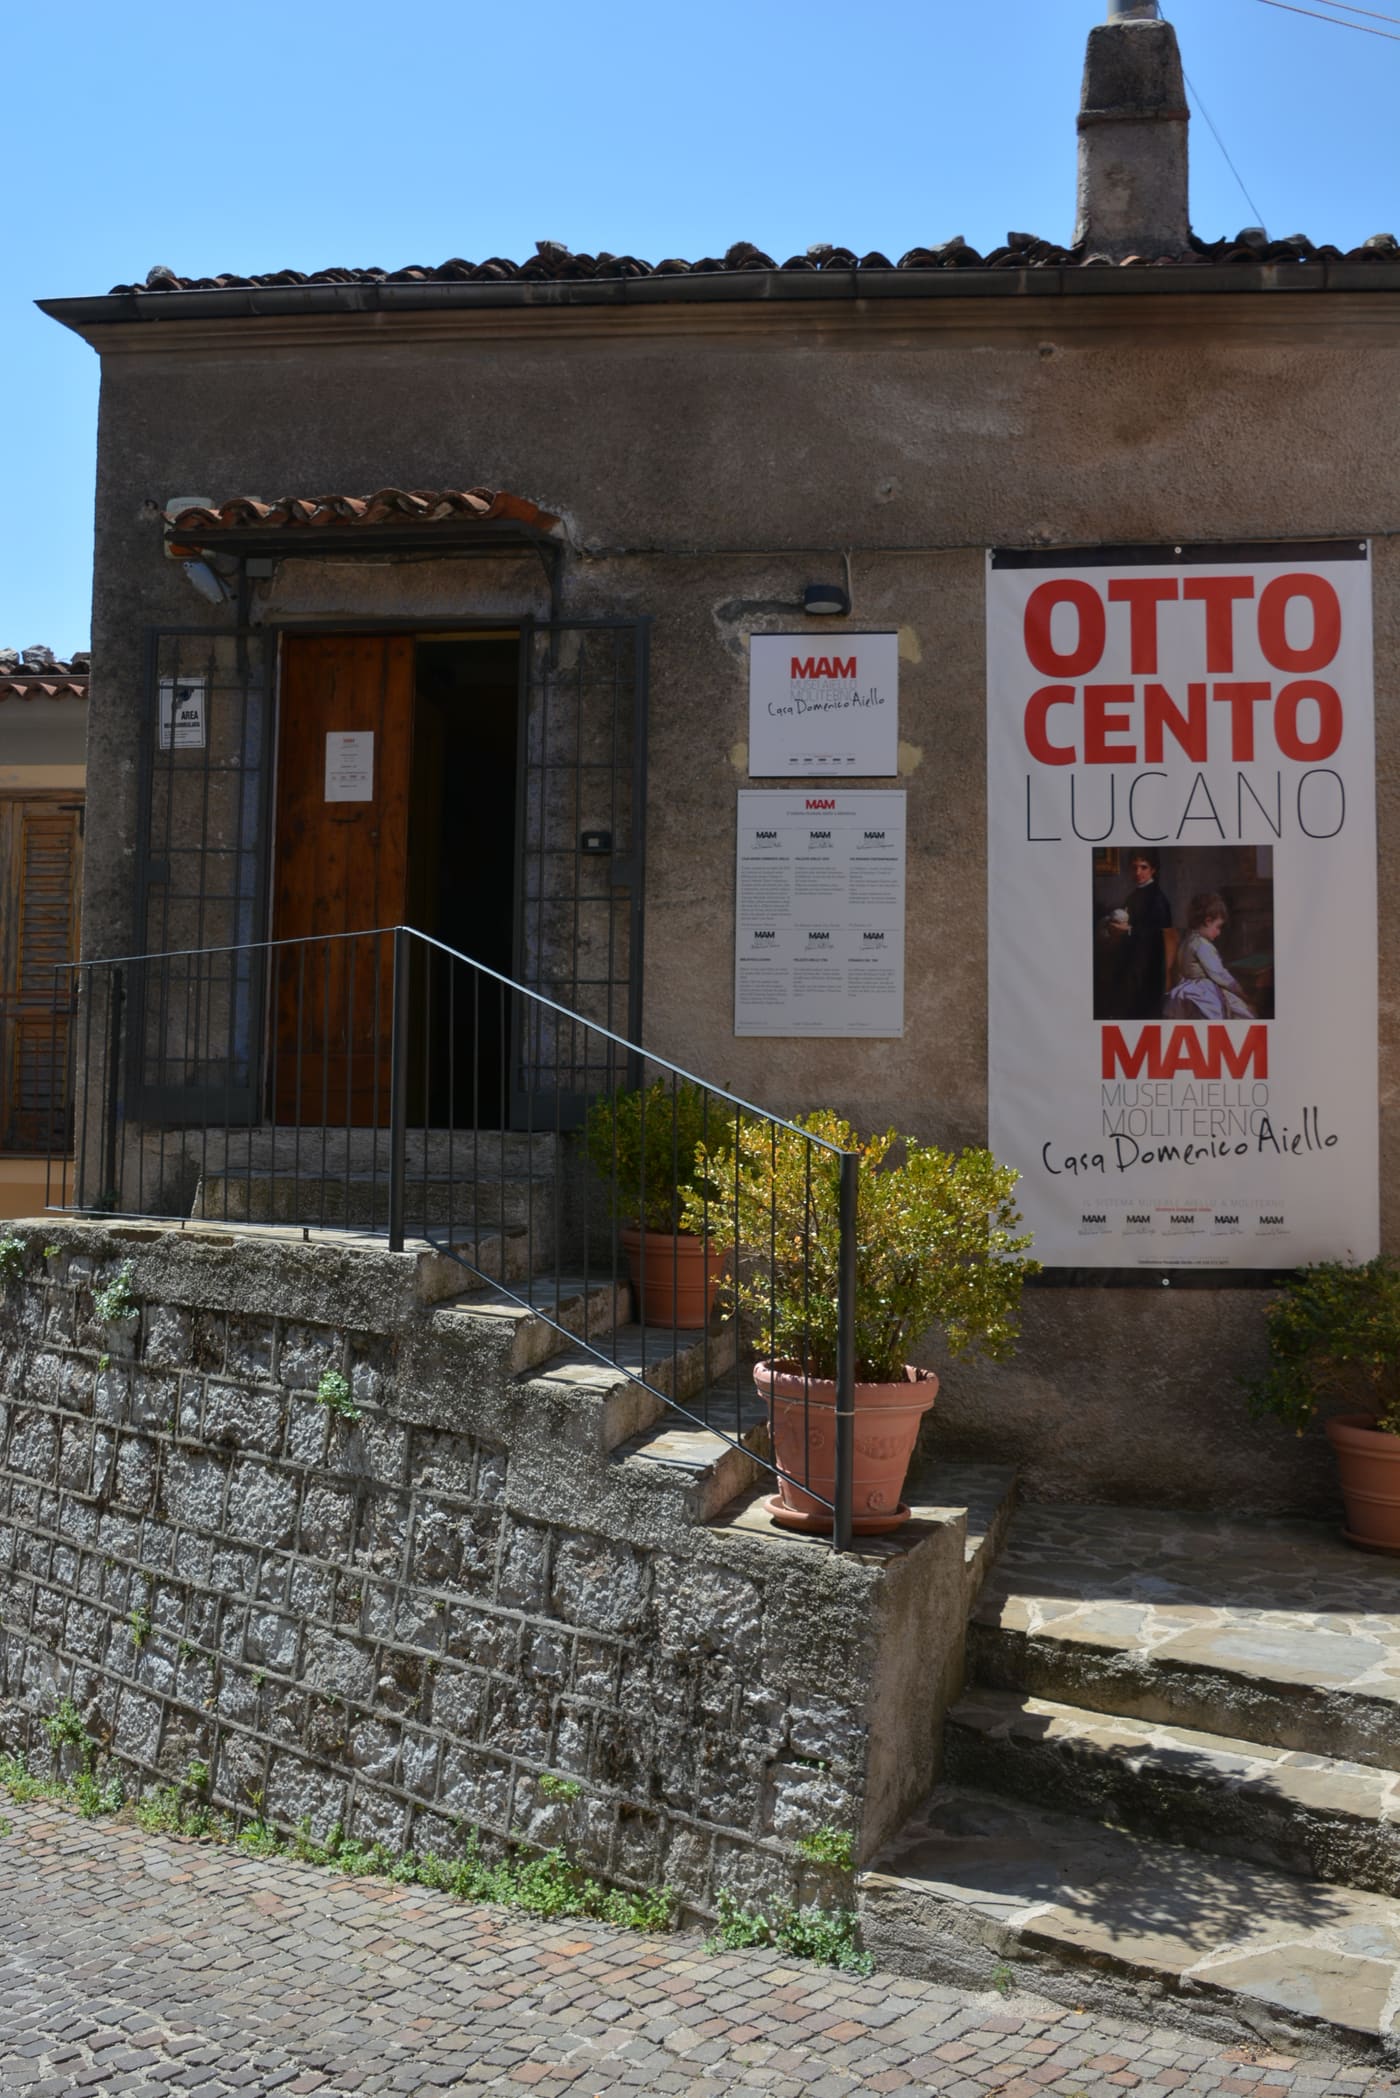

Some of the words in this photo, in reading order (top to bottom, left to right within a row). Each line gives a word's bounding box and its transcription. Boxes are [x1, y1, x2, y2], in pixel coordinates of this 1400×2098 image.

[1023, 573, 1342, 678] OTTO
[790, 656, 857, 679] MAM
[767, 702, 793, 716] Casa
[794, 698, 850, 715] Domenico
[852, 688, 885, 706] Aiello
[181, 710, 198, 720] AREA
[1023, 679, 1344, 766] CENTO
[805, 799, 836, 810] MAM
[1026, 768, 1345, 842] LUCANO
[756, 831, 777, 839] MAM
[810, 831, 831, 839] MAM
[864, 831, 885, 839] MAM
[754, 931, 775, 939] MAM
[808, 932, 830, 940] MAM
[863, 932, 885, 940] MAM
[1101, 1024, 1268, 1080] MAM
[1101, 1083, 1174, 1107] MUSEI
[1181, 1082, 1270, 1107] AIELLO
[1102, 1108, 1270, 1137] MOLITERNO
[1042, 1141, 1106, 1177] Casa
[1109, 1133, 1248, 1174] Domenico
[1257, 1106, 1339, 1156] Aiello
[1082, 1214, 1107, 1225] MAM
[1126, 1214, 1151, 1225] MAM
[1170, 1214, 1195, 1225] MAM
[1214, 1214, 1239, 1225] MAM
[1259, 1214, 1284, 1225] MAM
